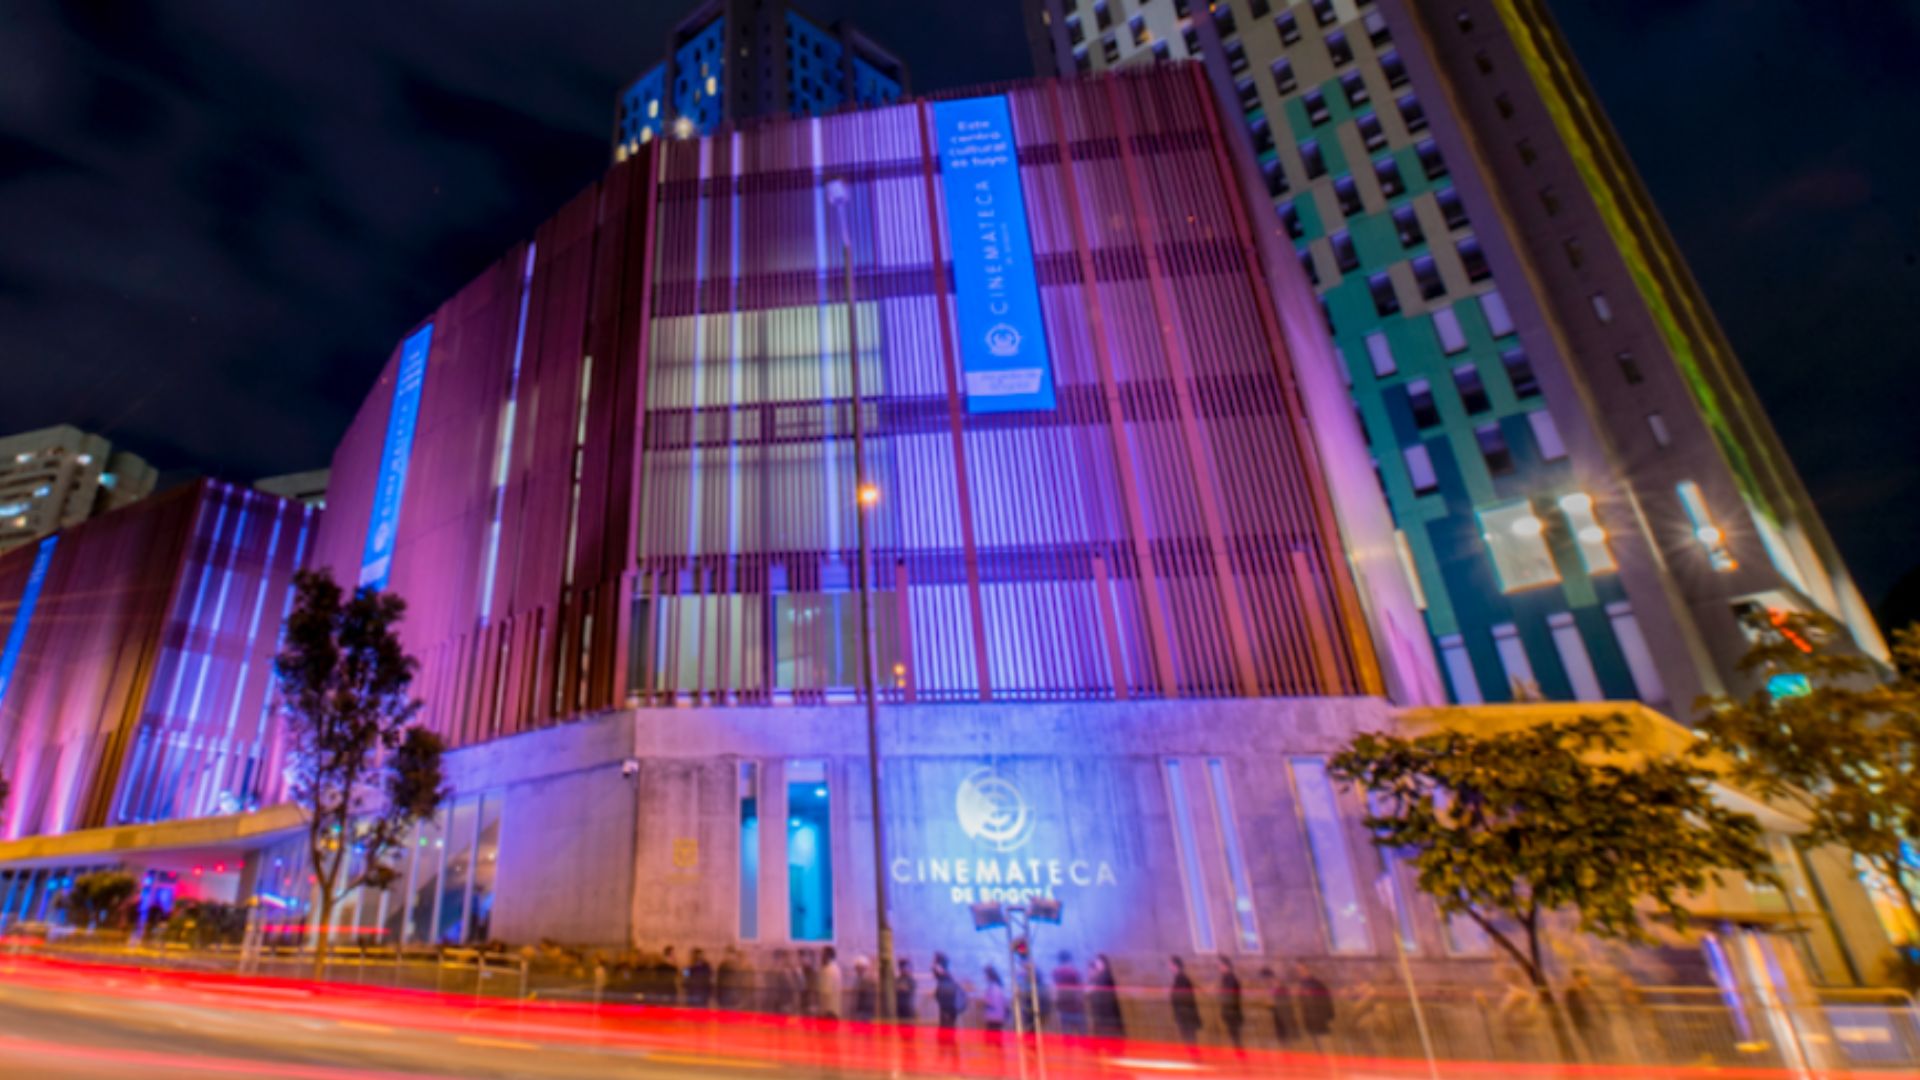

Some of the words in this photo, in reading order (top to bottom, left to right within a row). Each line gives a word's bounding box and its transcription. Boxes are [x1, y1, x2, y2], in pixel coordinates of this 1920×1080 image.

[975, 180, 1009, 315] CINEMATECA
[891, 857, 1117, 887] CINEMATECA
[951, 886, 974, 904] DE
